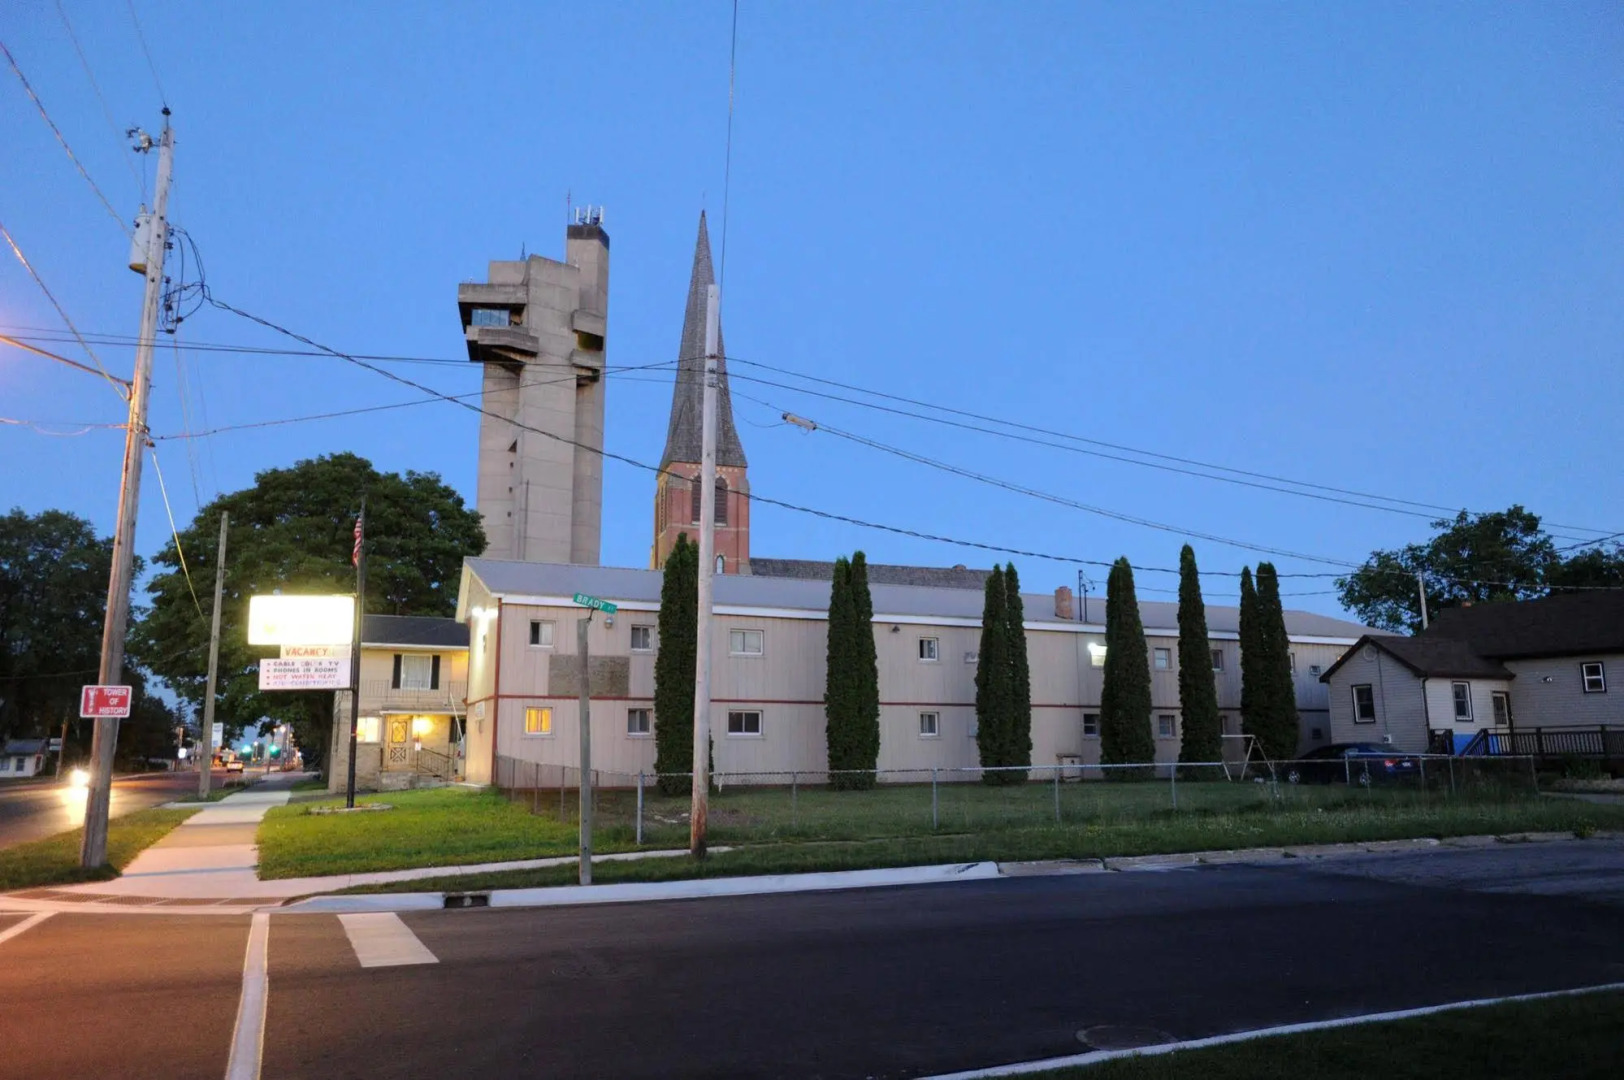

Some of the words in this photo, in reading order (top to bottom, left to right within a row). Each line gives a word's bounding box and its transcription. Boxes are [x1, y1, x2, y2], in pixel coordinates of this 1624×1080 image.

[576, 594, 605, 609] BRADY
[285, 647, 329, 656] VACANCY
[104, 688, 128, 697] TOWER
[109, 697, 119, 705] OF
[99, 706, 128, 714] HISTORY
